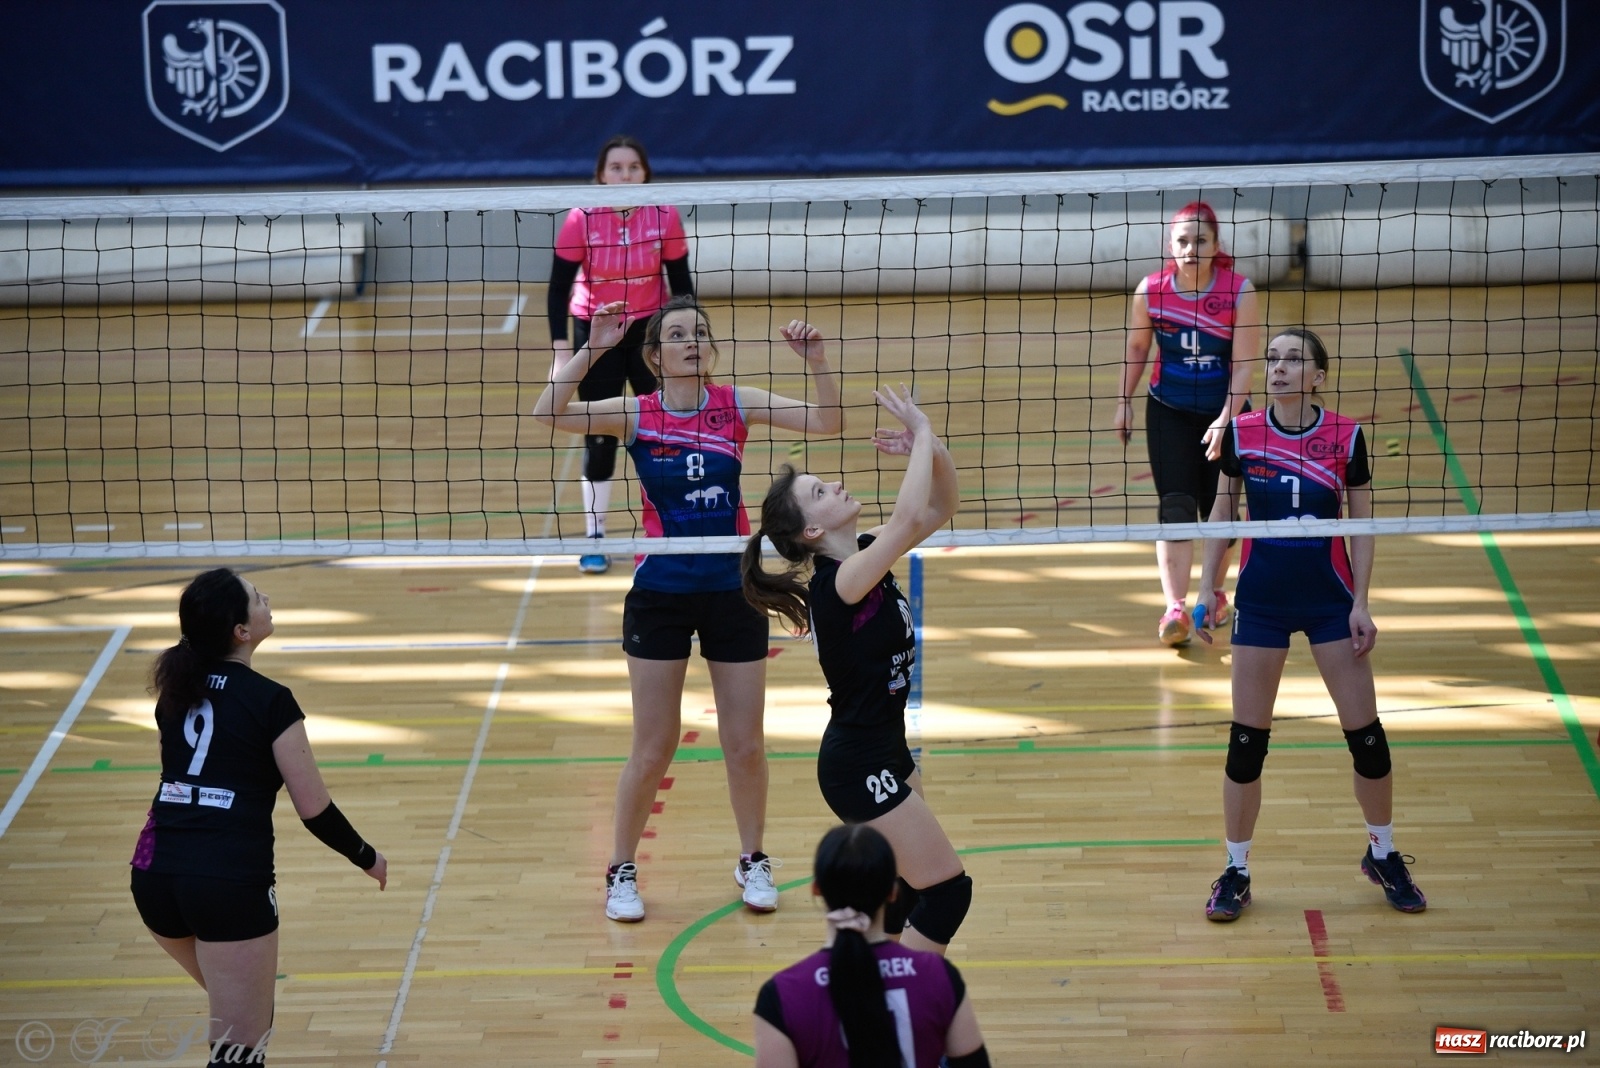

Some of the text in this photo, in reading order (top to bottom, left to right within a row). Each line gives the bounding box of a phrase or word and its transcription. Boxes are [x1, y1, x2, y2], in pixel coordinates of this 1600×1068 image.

[371, 16, 796, 103] RACIBÓRZ
[1082, 81, 1231, 112] RACIBÓRZ
[1180, 331, 1201, 355] 4
[686, 453, 705, 481] 8
[1280, 475, 1300, 508] 7
[183, 698, 214, 776] 9
[866, 769, 899, 804] 20
